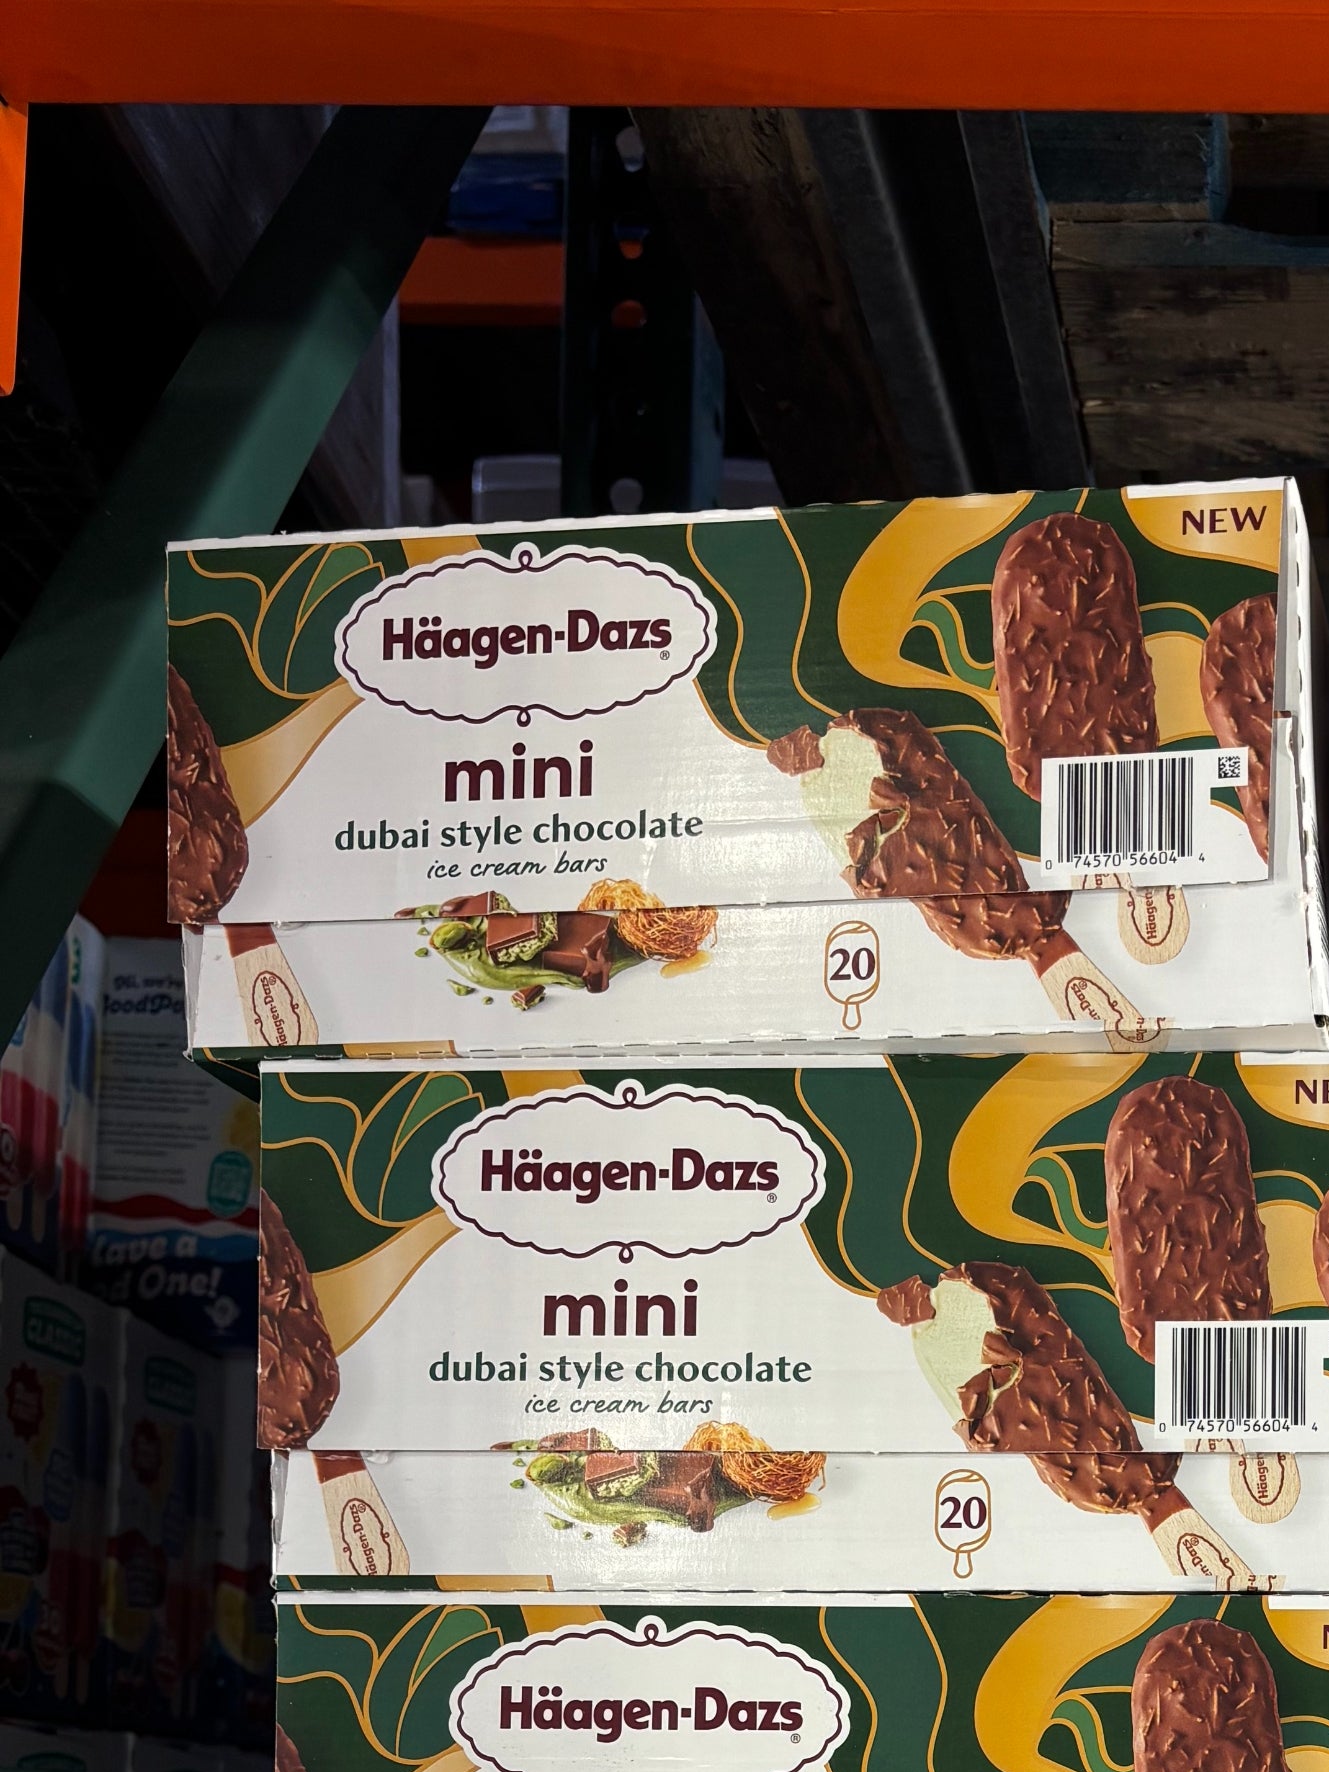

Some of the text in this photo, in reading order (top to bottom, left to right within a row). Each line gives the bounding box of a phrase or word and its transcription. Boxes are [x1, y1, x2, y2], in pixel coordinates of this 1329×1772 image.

[1182, 506, 1267, 535] NEW
[383, 610, 672, 669] Häagen-Dazs
[445, 740, 593, 802] mini
[335, 809, 703, 853] dubai style chocolate
[427, 850, 607, 879] ice cream bars
[1073, 852, 1177, 868] 74570 56604
[830, 948, 875, 980] 20
[481, 1148, 779, 1204] Häagen-Dazs
[544, 1279, 698, 1336] mini
[429, 1351, 812, 1389] dubai style chocolate
[525, 1390, 713, 1413] ice cream bars
[1187, 1419, 1291, 1432] 74570 56604
[940, 1497, 987, 1529] 20
[500, 1686, 803, 1743] Häagen-Dazs
